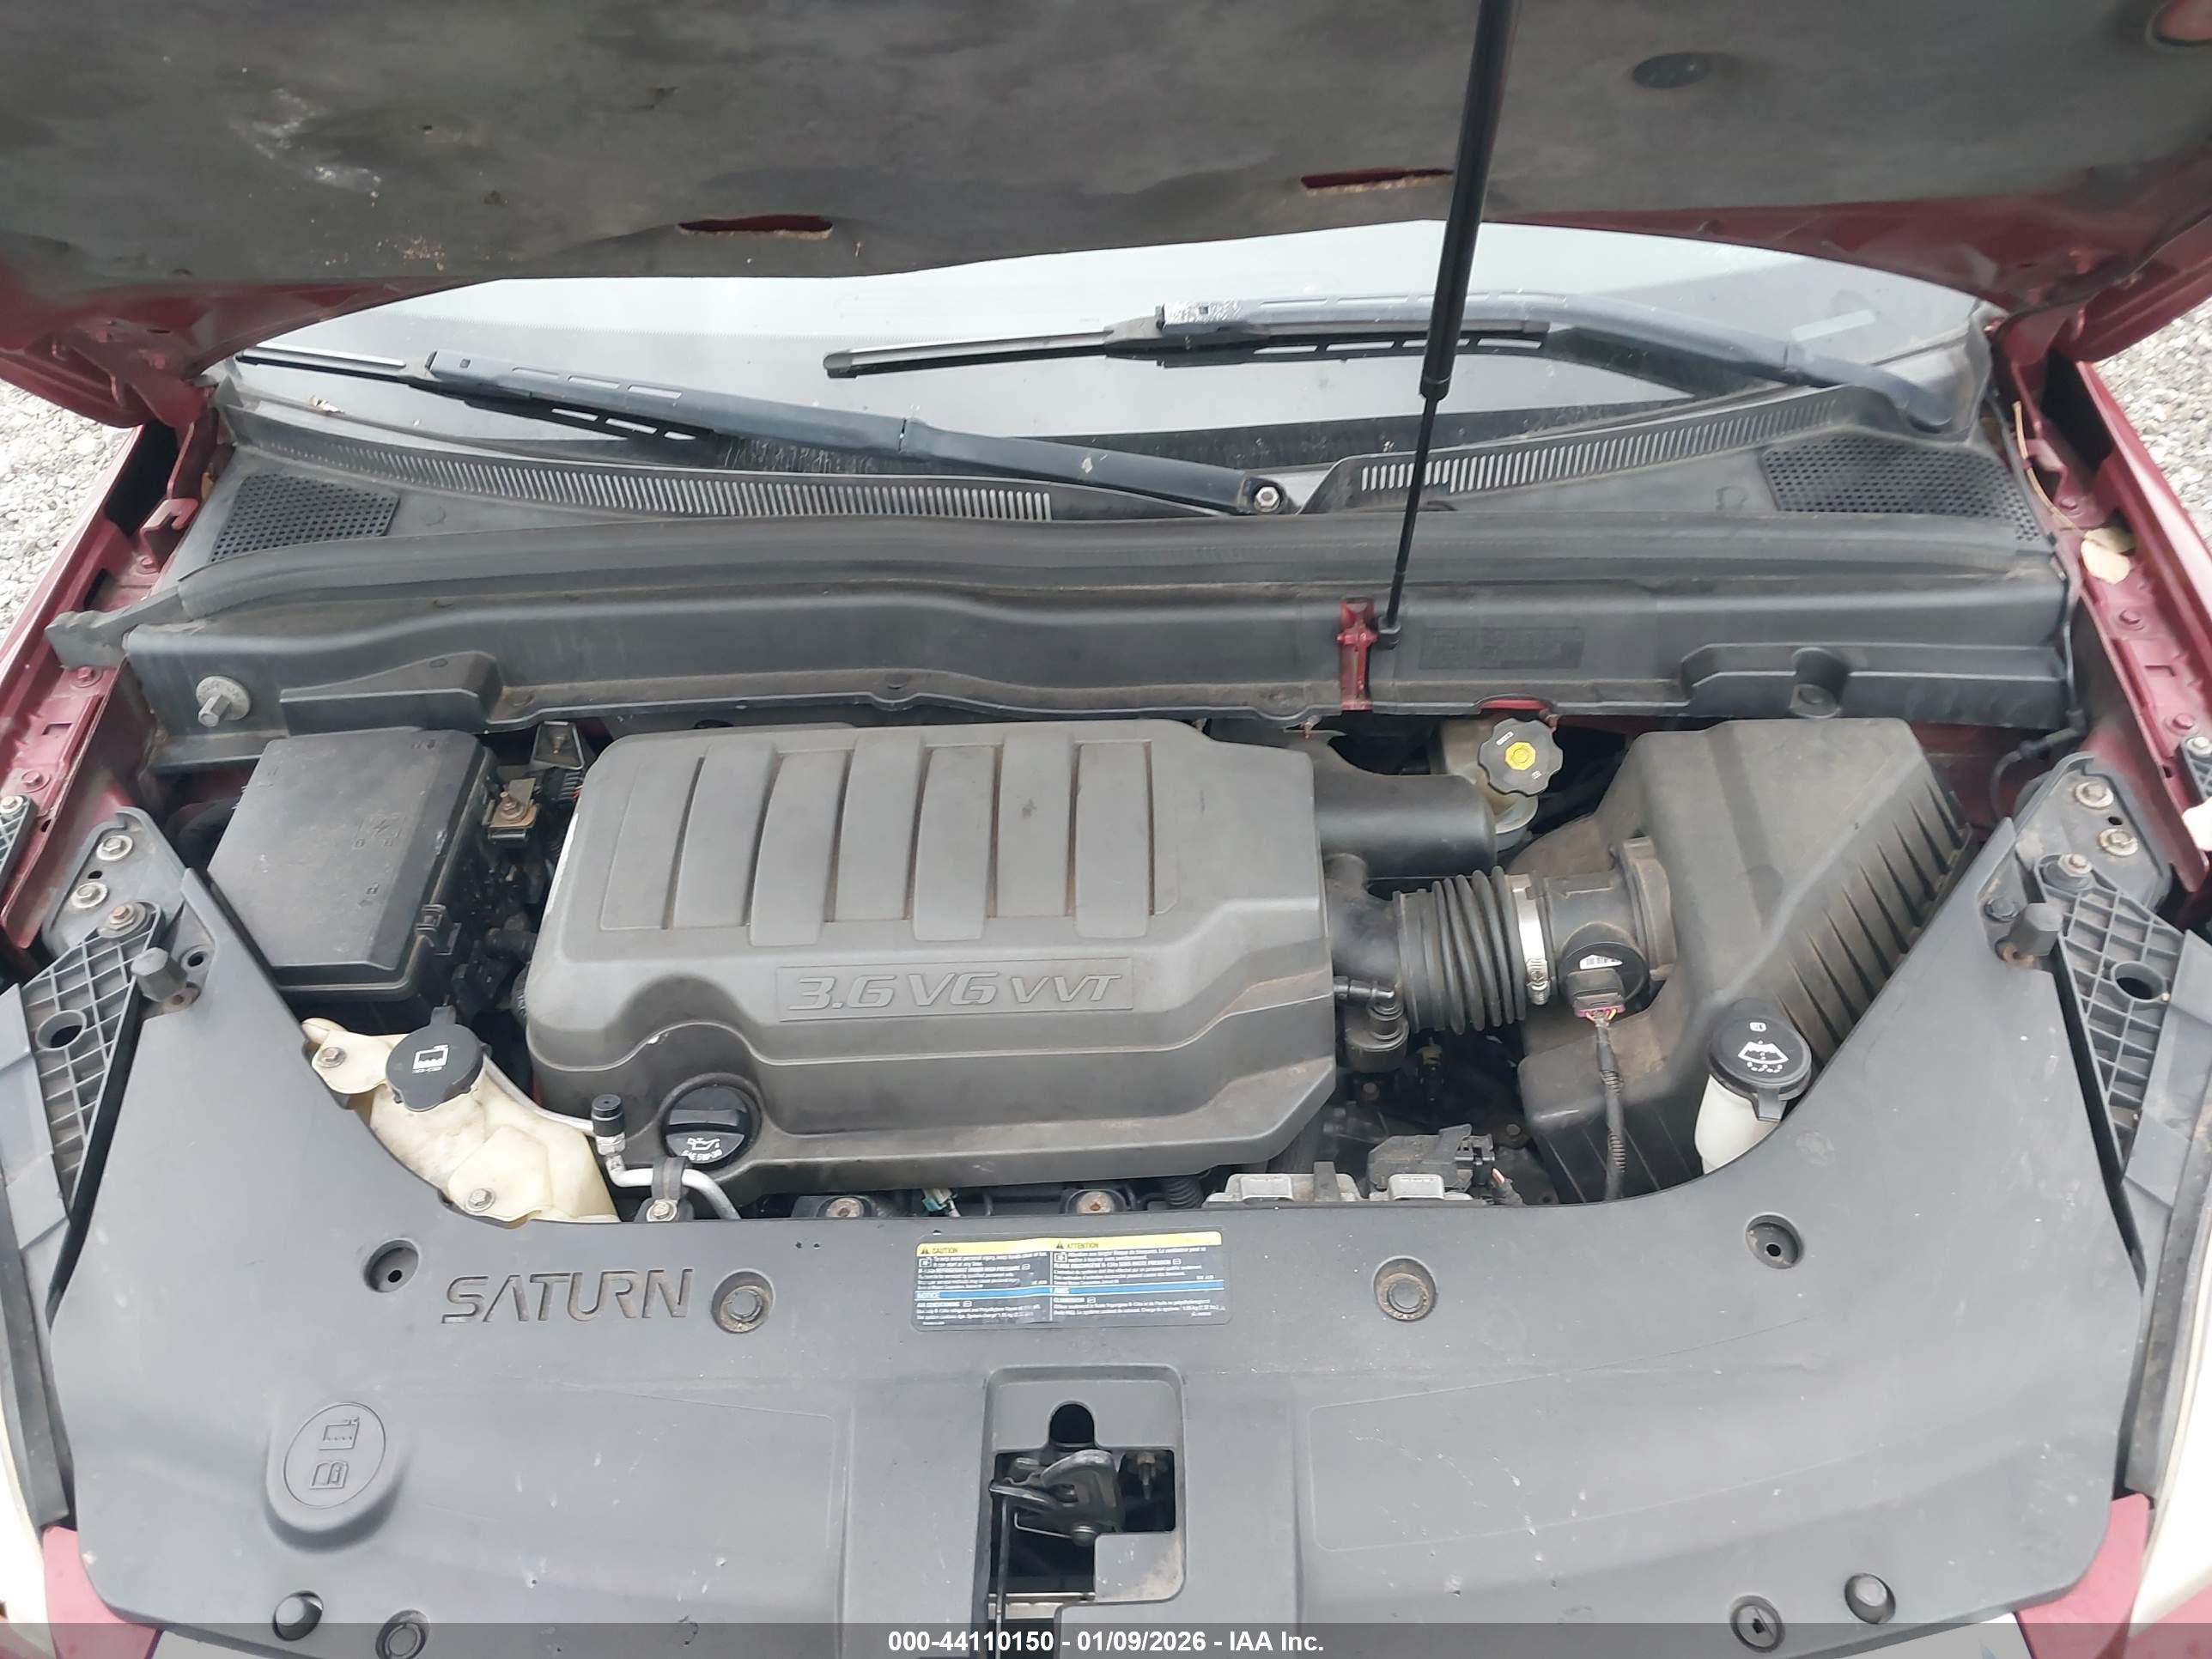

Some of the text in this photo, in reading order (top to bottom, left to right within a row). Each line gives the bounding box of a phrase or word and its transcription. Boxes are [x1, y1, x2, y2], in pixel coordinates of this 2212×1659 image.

[788, 971, 1122, 1010] 3.6 V6 VVT
[441, 1268, 694, 1323] SATURN
